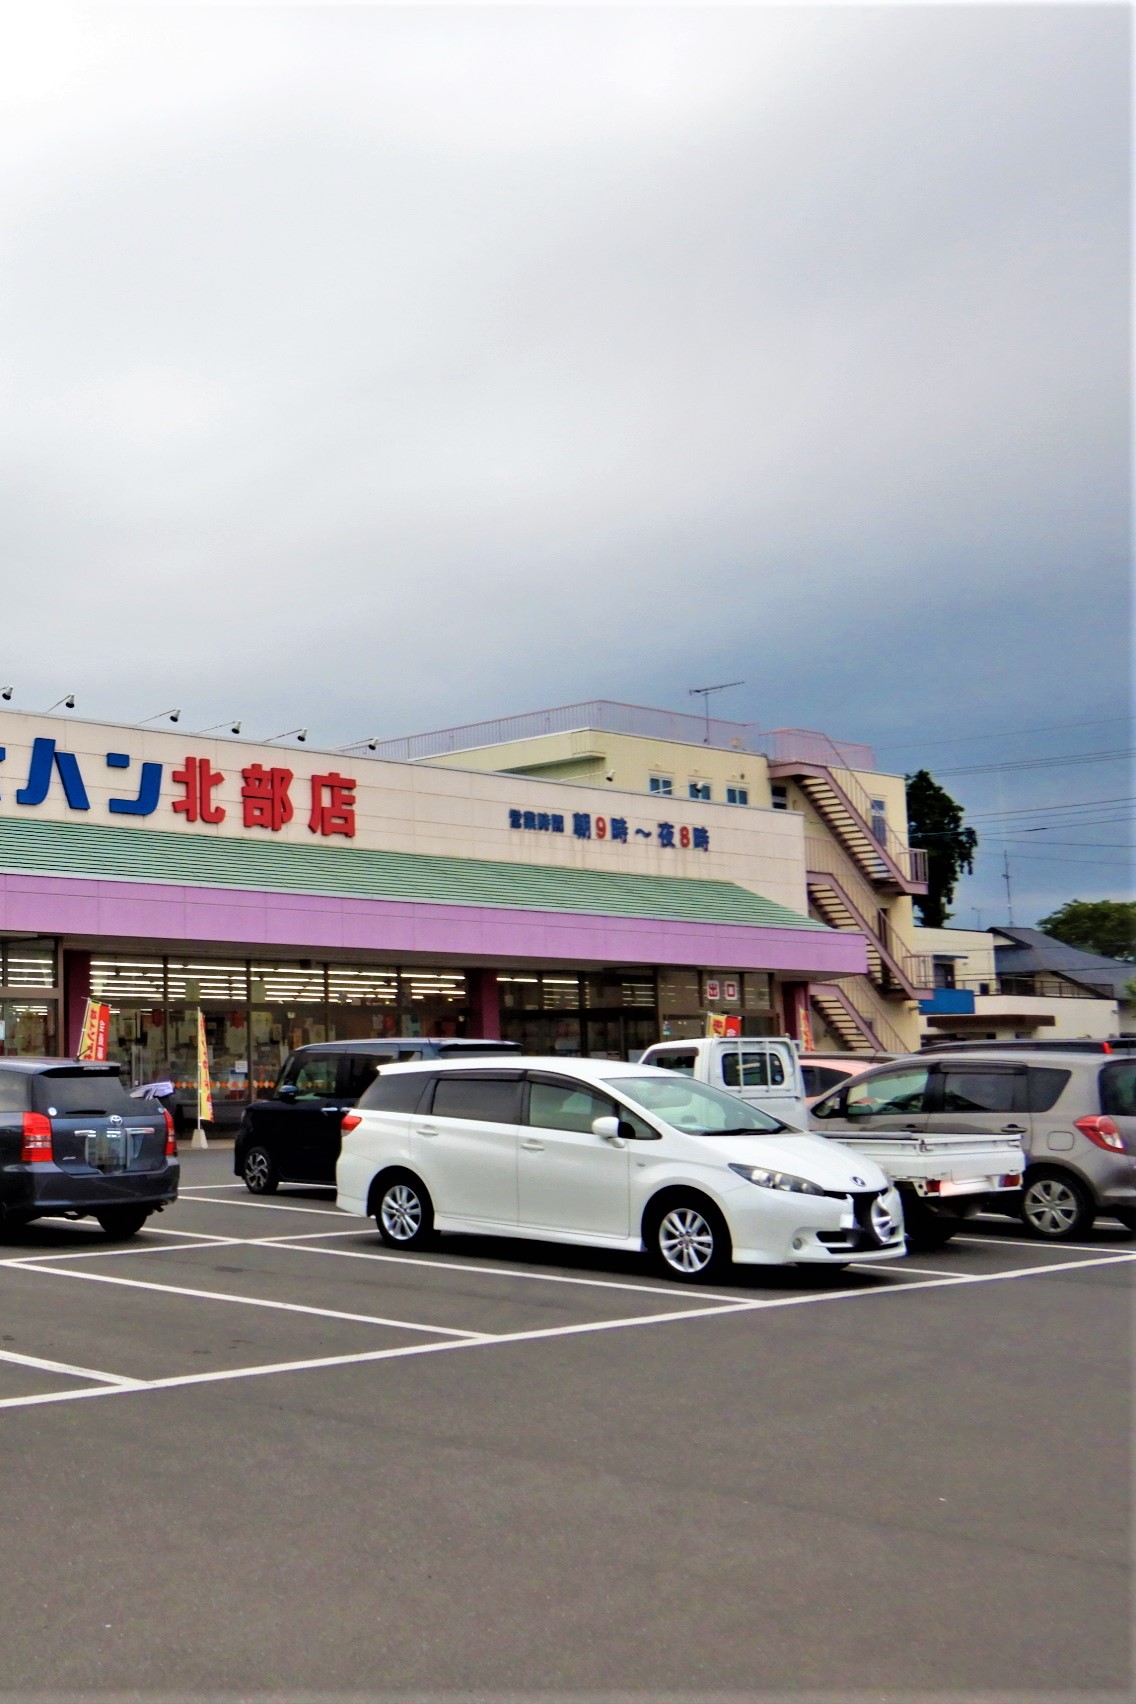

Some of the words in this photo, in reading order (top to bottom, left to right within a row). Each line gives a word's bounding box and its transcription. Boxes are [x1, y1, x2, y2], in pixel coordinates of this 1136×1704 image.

[171, 755, 357, 838] 北部店
[709, 983, 735, 997] 出口
